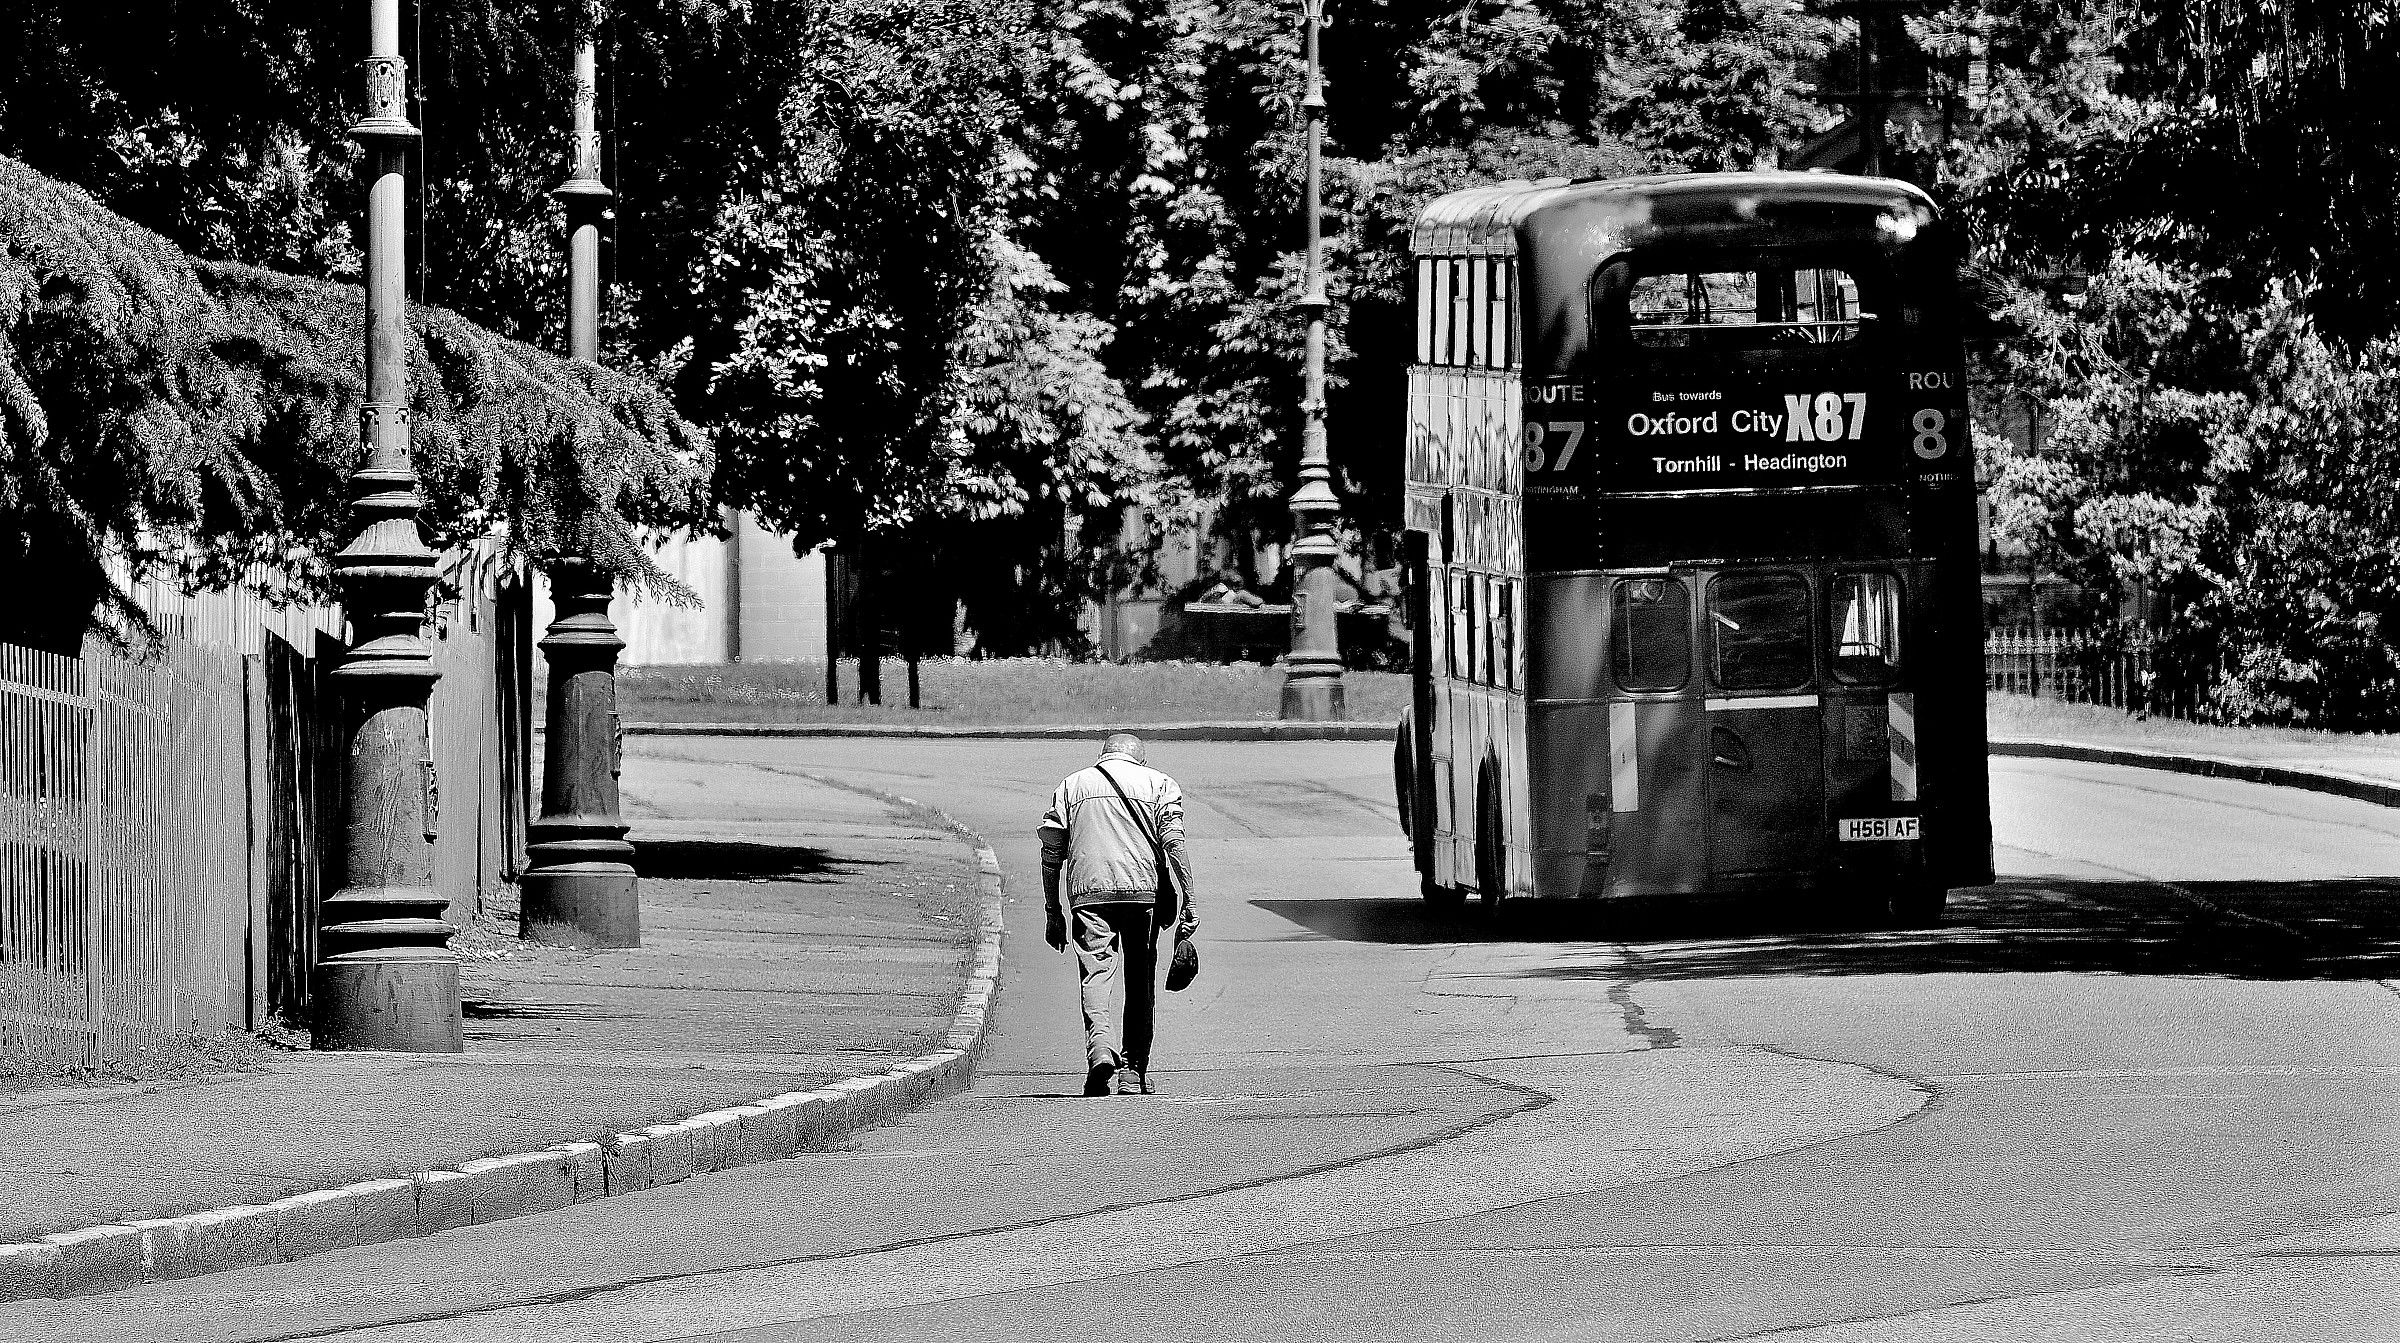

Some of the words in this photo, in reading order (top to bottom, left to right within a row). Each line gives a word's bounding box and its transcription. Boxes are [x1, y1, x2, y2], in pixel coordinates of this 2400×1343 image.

[1652, 391, 1675, 402] Bus
[1679, 390, 1722, 401] towards
[1627, 410, 1718, 437] Oxford
[1732, 409, 1783, 438] City
[1783, 391, 1867, 442] X87
[1524, 421, 1585, 472] 87
[1652, 455, 1721, 474] Tornhill
[1744, 453, 1847, 473] Headington
[1894, 819, 1917, 837] AF
